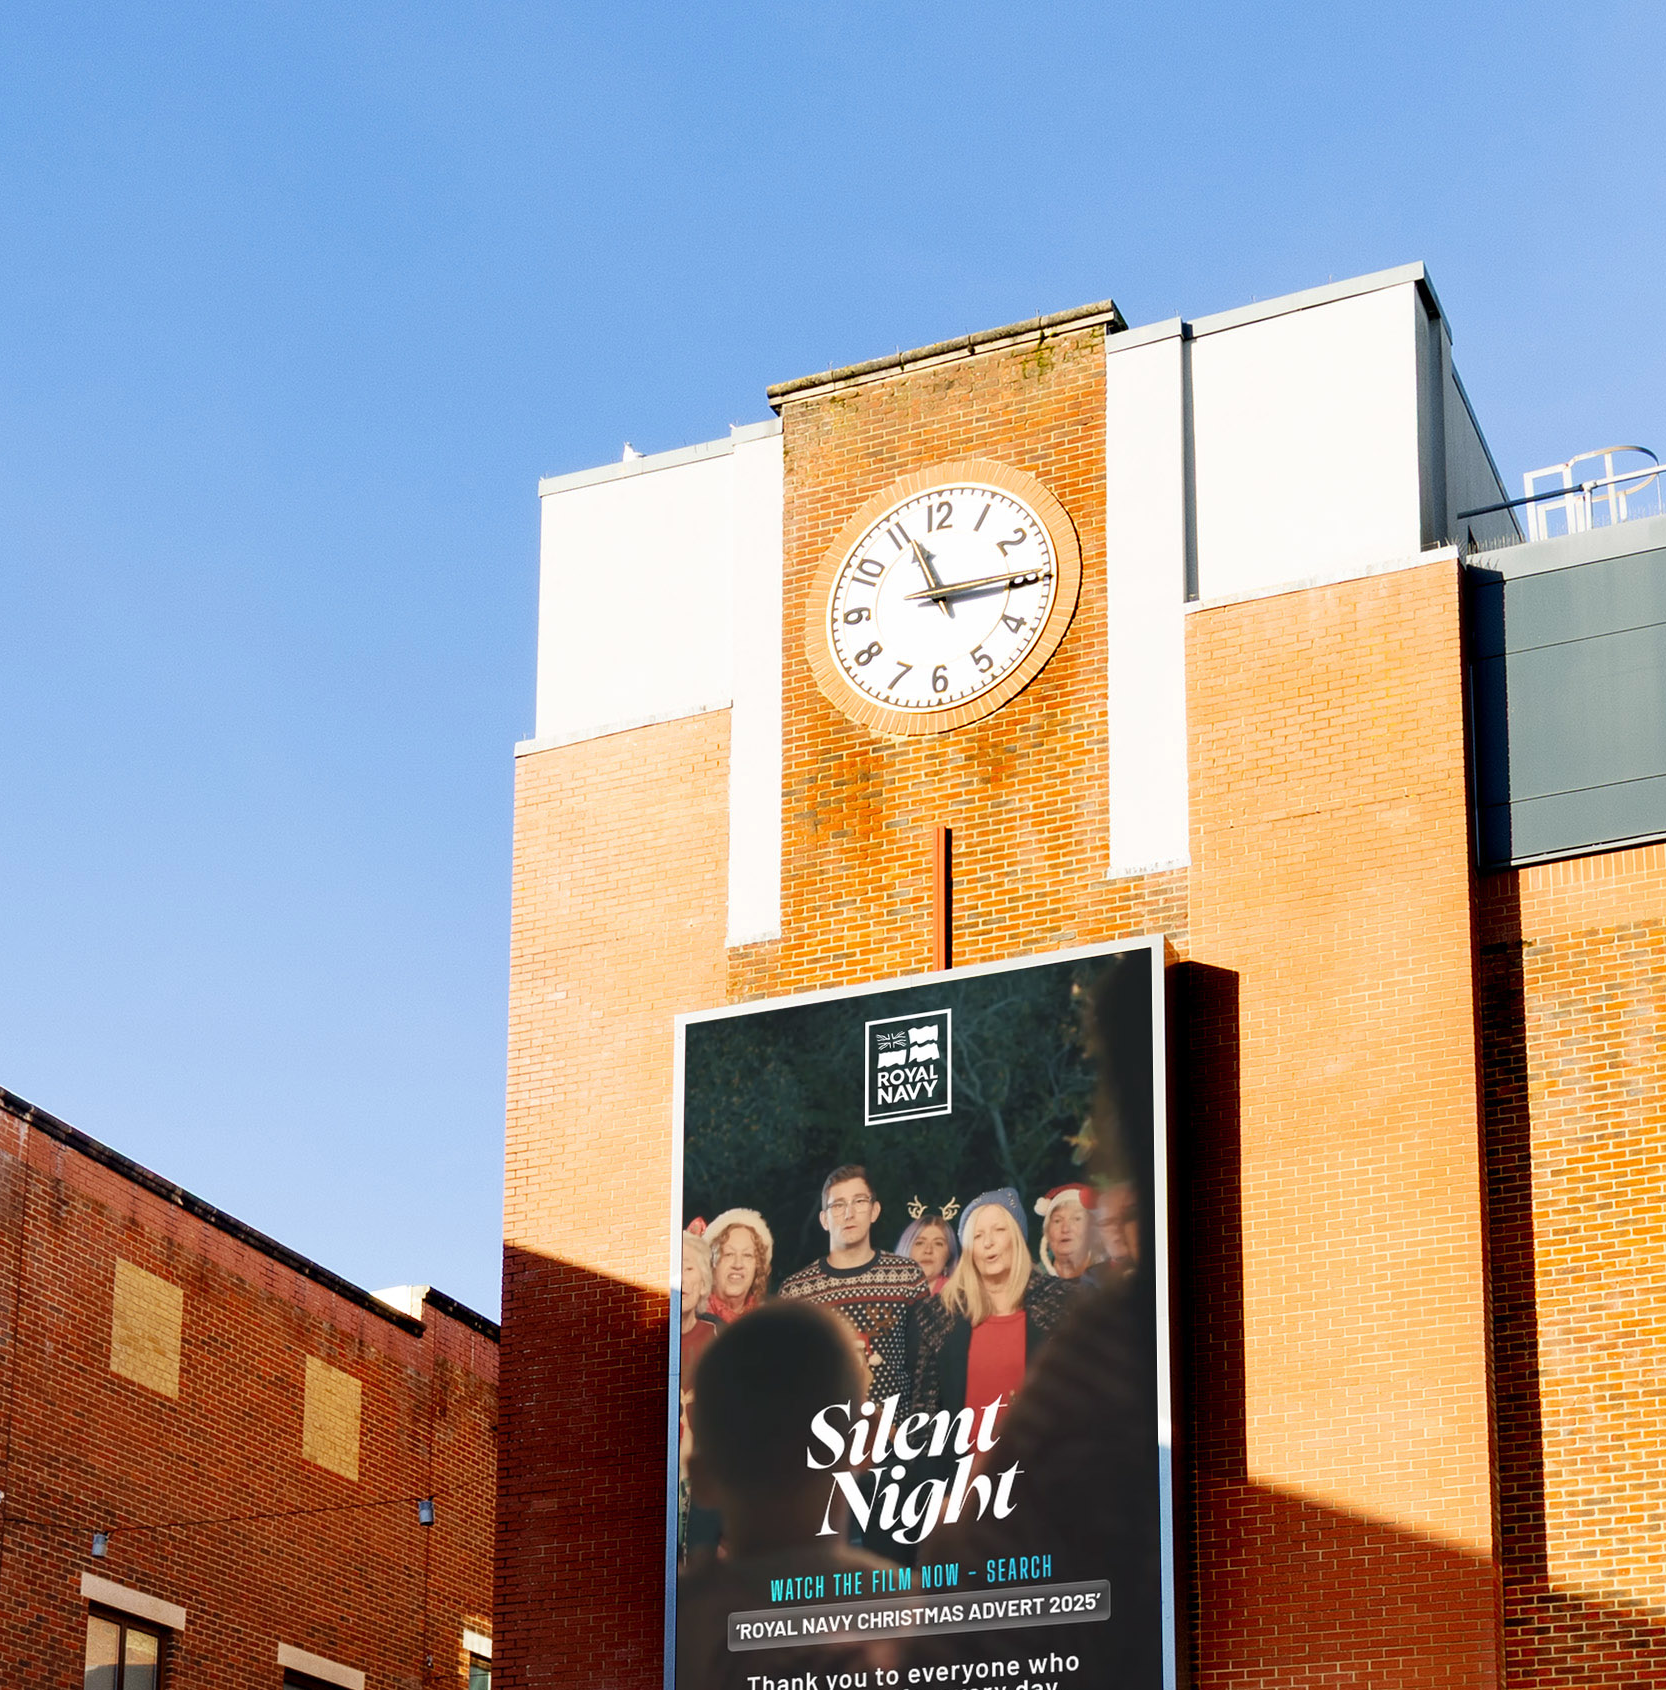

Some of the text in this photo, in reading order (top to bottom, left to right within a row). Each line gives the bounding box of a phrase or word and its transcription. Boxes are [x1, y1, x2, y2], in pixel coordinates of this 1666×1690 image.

[927, 501, 952, 532] 12
[974, 504, 991, 531] 1
[887, 522, 911, 550] 11
[996, 527, 1027, 557] 2
[853, 558, 885, 587] 10
[843, 607, 871, 626] 9
[1001, 614, 1027, 634] 4
[855, 640, 883, 666] 8
[970, 645, 993, 674] 5
[888, 661, 912, 690] 7
[931, 665, 949, 694] 6
[877, 1064, 939, 1087] ROYAL
[877, 1079, 939, 1105] NAVY
[807, 1393, 1009, 1470] Silent
[815, 1453, 1025, 1544] Night
[770, 1575, 825, 1602] WATCH
[833, 1571, 863, 1596] THE
[872, 1567, 912, 1593] FILM
[921, 1562, 960, 1589] NOW
[986, 1554, 1052, 1583] SEARCH
[802, 1614, 854, 1635] NAVY
[857, 1604, 964, 1630] CHRISTMAS
[968, 1597, 1046, 1621] ADVERT
[874, 1667, 899, 1687] to
[908, 1660, 1020, 1685] everyone
[1028, 1652, 1079, 1675] who
